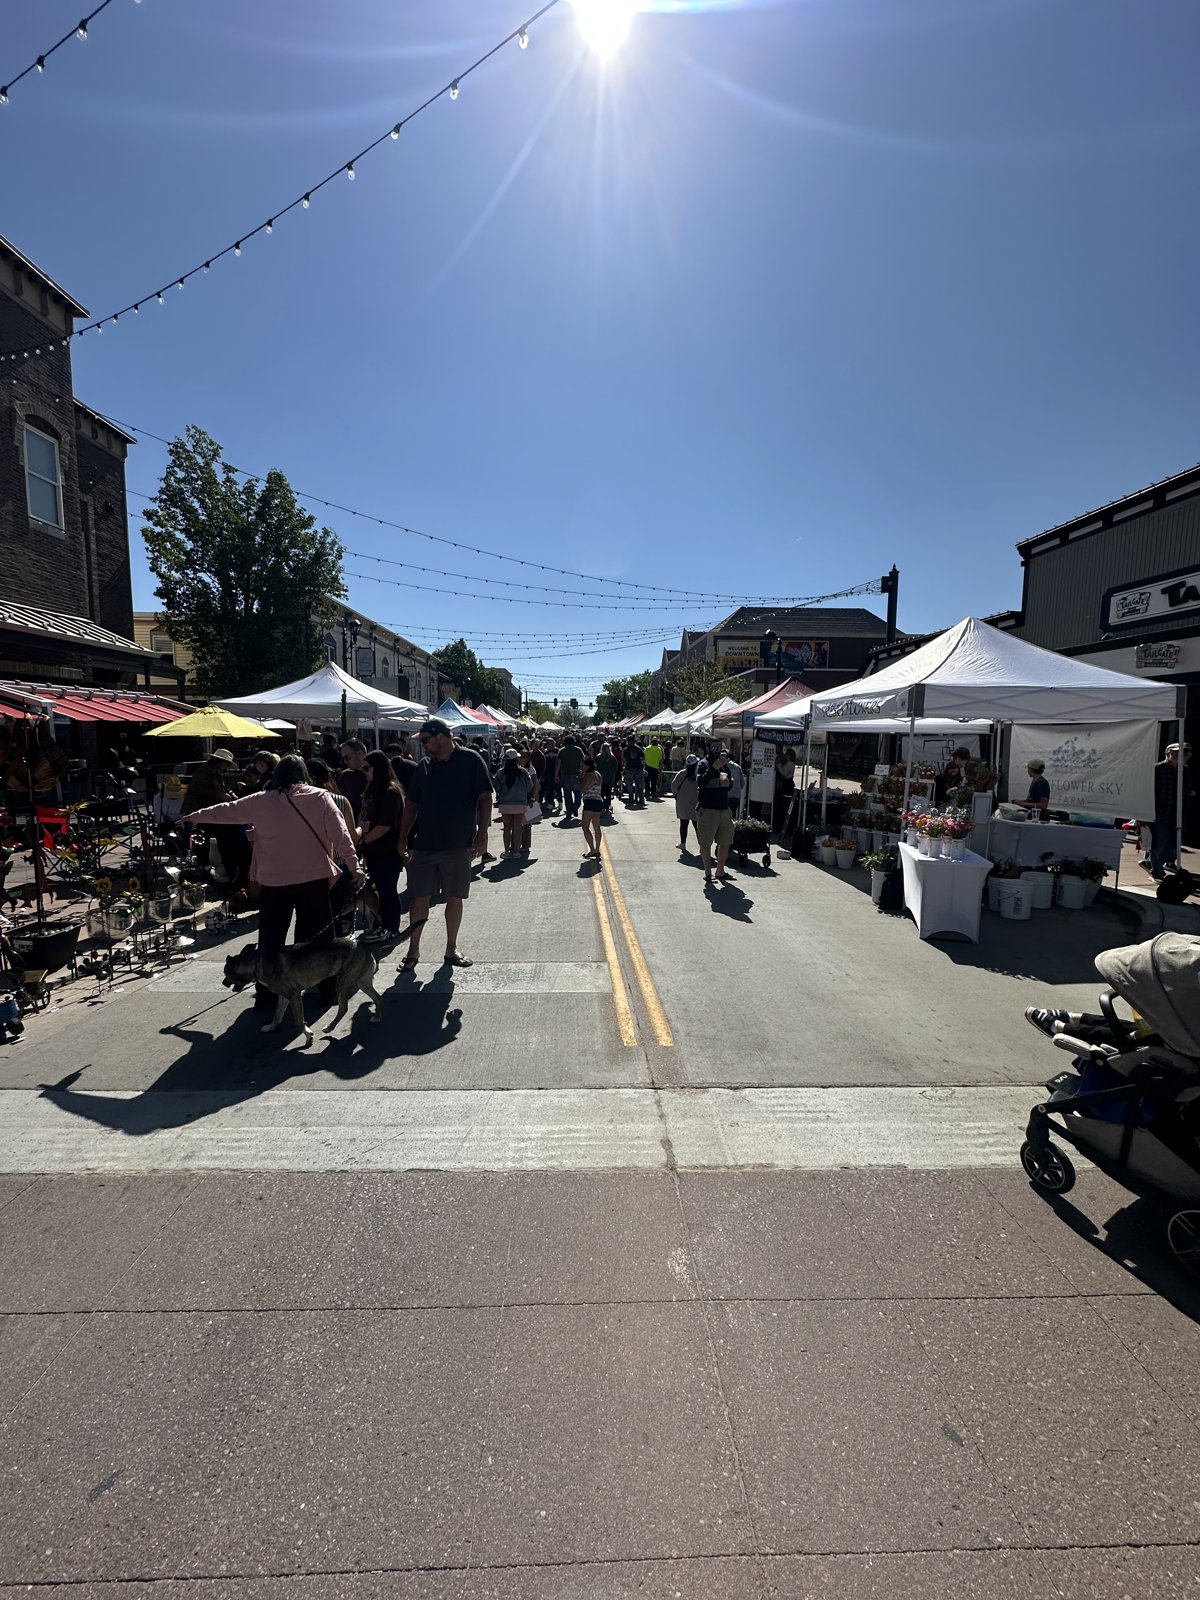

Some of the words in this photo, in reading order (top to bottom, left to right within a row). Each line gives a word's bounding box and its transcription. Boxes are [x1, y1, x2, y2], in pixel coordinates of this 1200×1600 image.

[722, 658, 765, 668] PARKER
[1099, 783, 1123, 795] SKY
[1058, 795, 1086, 806] FARM
